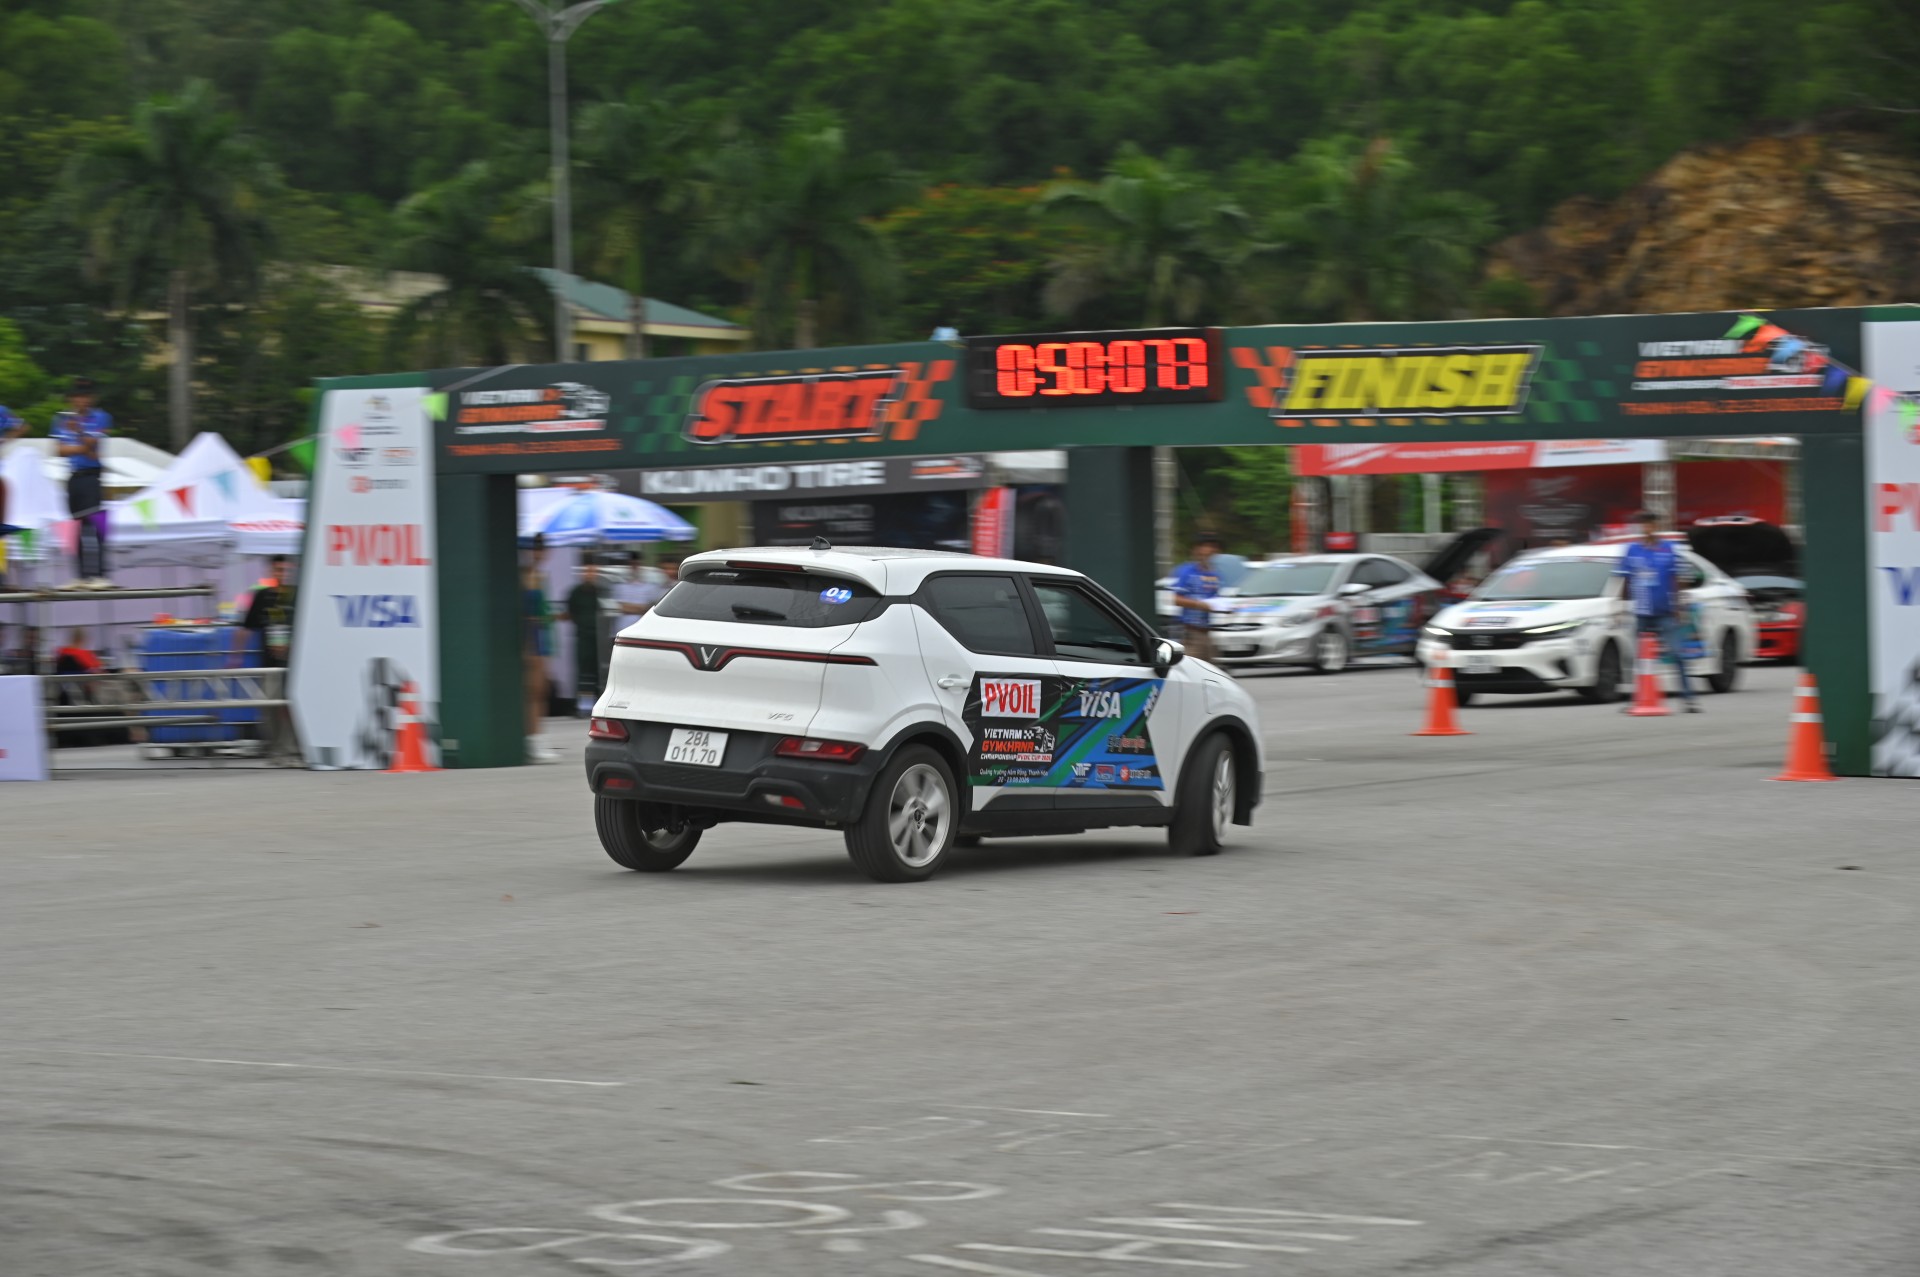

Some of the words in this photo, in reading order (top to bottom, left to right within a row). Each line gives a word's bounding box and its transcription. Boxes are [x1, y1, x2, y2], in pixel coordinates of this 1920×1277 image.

[1283, 352, 1534, 412] FINISH
[690, 377, 899, 438] START
[640, 466, 791, 495] KUMHO
[791, 460, 887, 487] TIRE
[825, 586, 849, 600] 01
[984, 683, 1037, 714] PVOIL
[1078, 690, 1122, 719] VISA
[685, 731, 710, 748] 28A
[983, 728, 1023, 740] VIETNAM
[670, 746, 717, 764] 011.70
[981, 740, 1035, 752] GYMKHANA
[980, 753, 1017, 761] CHAMPIONSHIP
